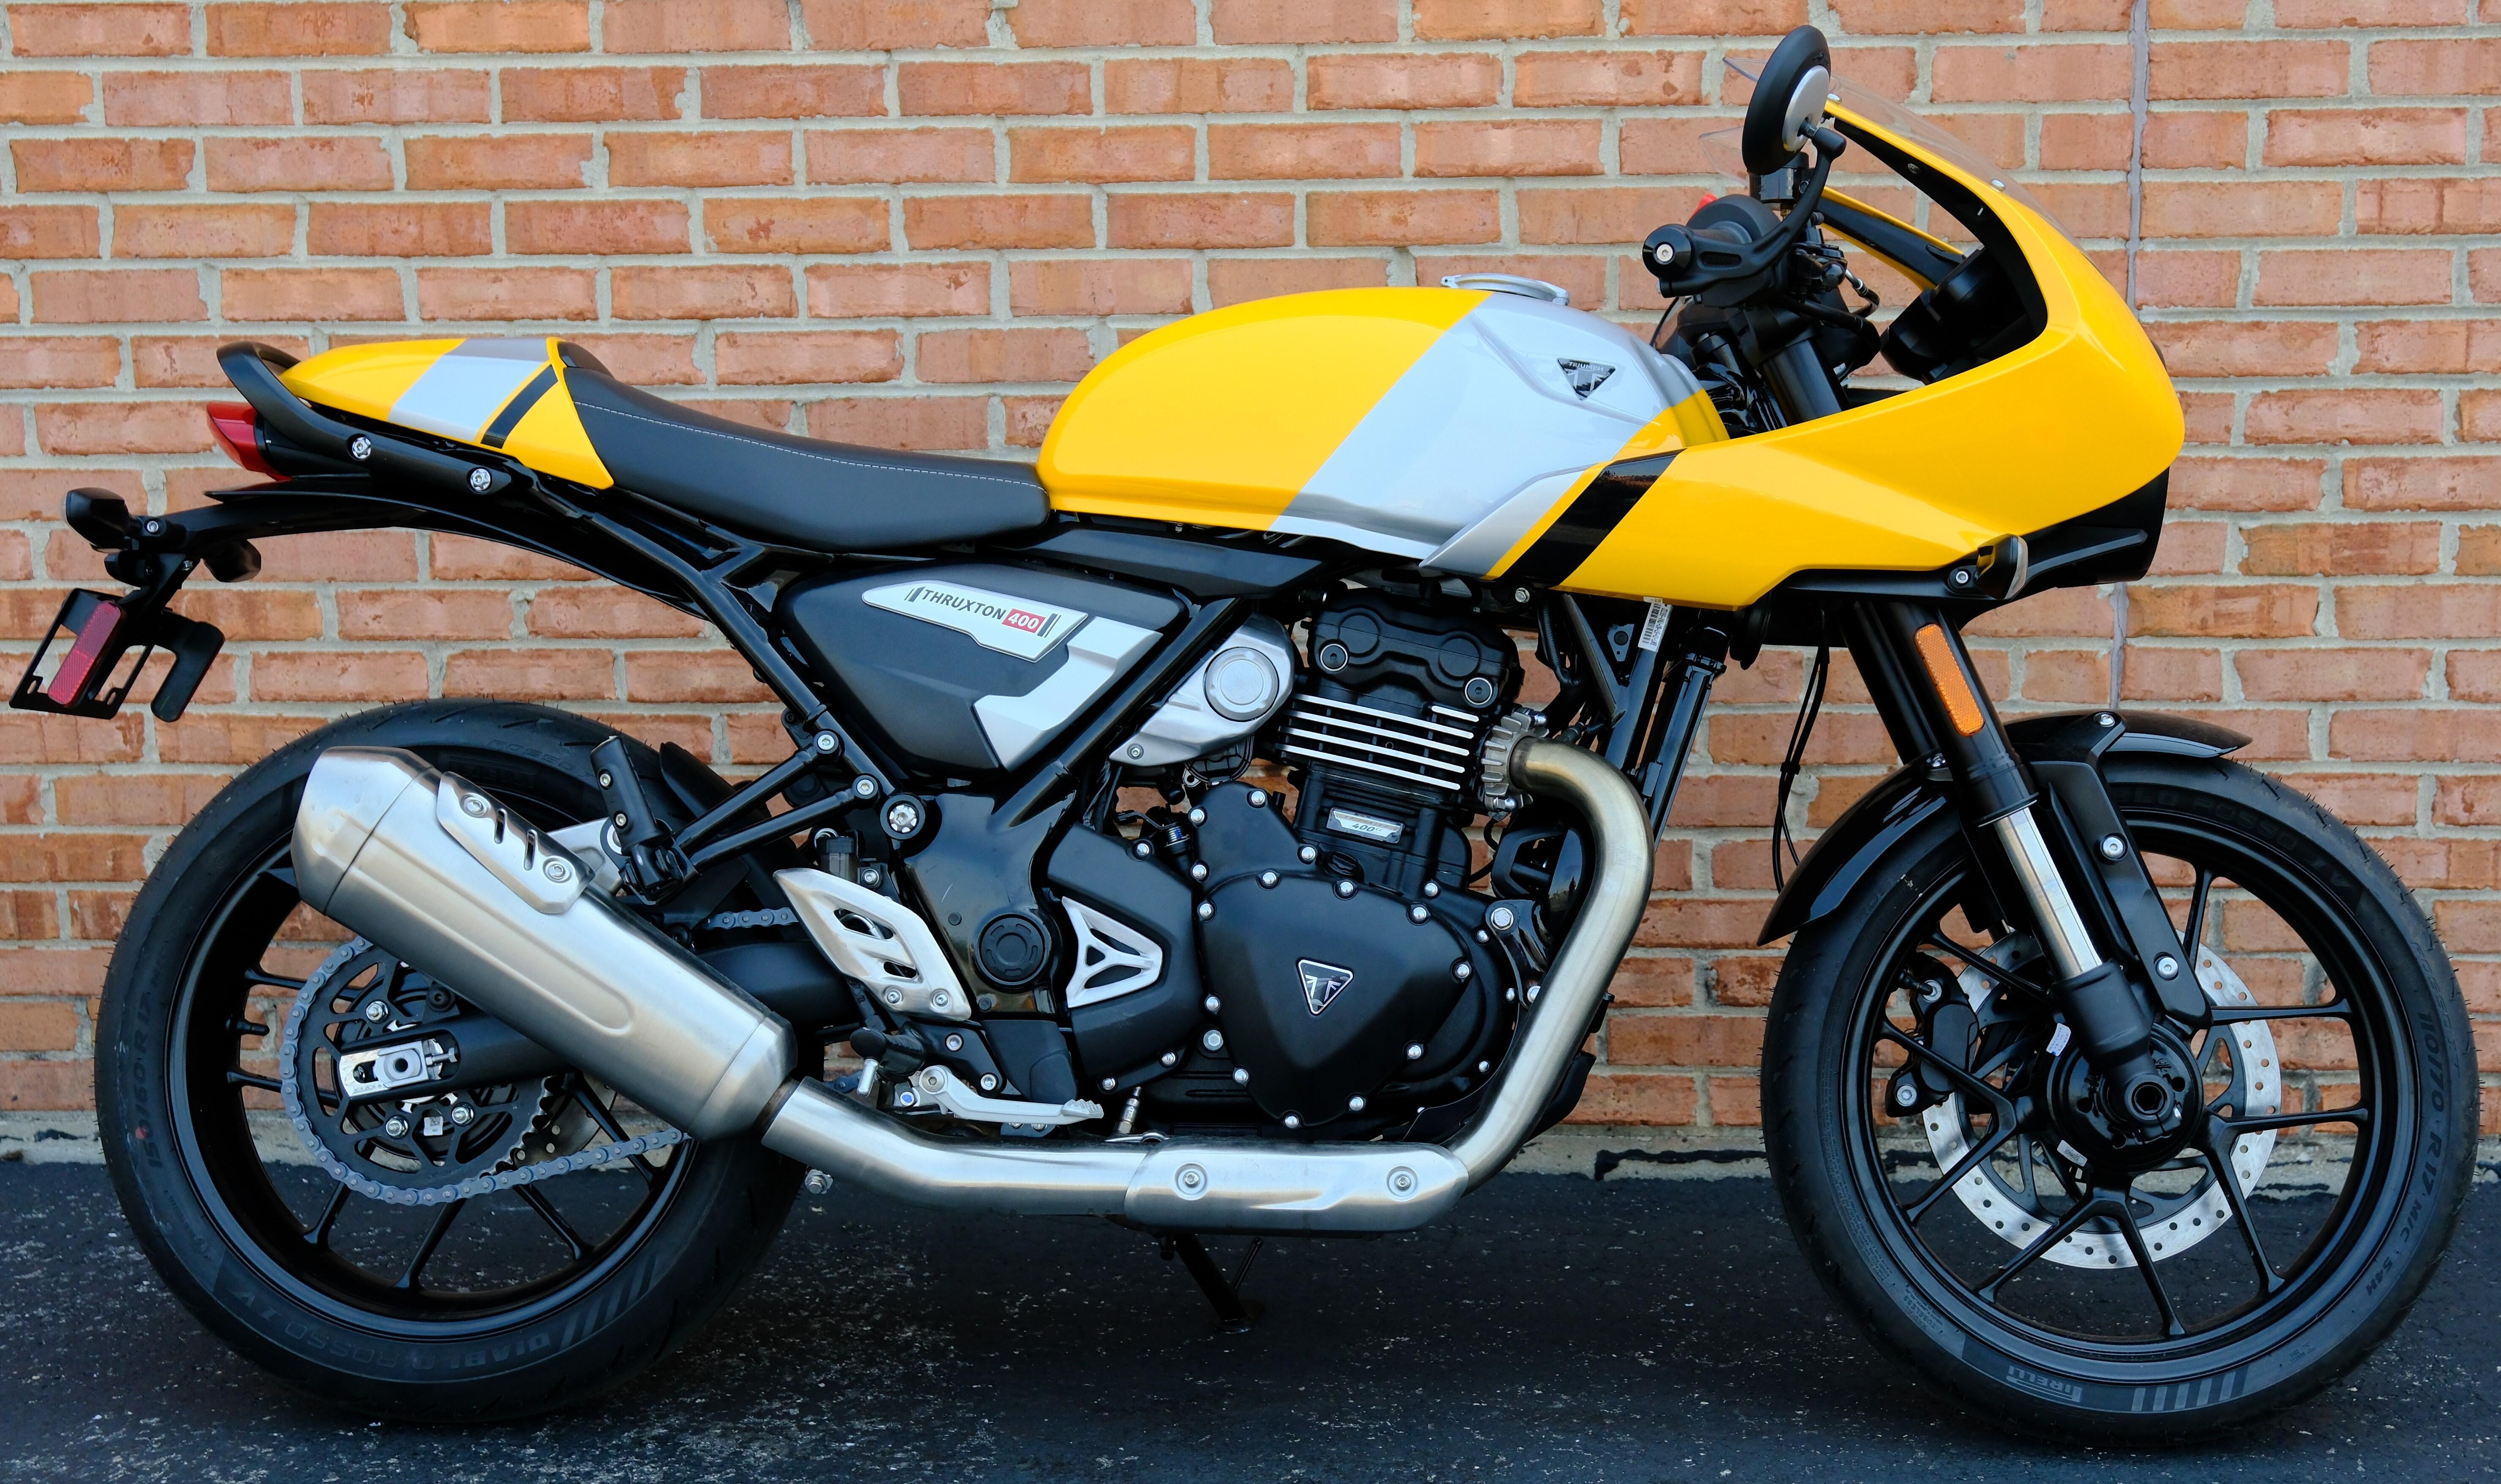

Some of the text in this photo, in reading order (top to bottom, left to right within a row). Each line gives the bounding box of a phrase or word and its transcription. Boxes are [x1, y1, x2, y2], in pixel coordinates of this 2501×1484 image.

[1569, 361, 1604, 372] TRIUMPH
[922, 589, 1039, 629] THRUXTON 400
[2193, 796, 2298, 850] ROSSO
[2419, 1013, 2444, 1112] 110/70
[133, 1062, 164, 1171] 150/60
[2400, 1200, 2422, 1241] M/C
[2366, 1258, 2392, 1295] 54H
[1904, 1296, 1935, 1328] TUBELESS
[285, 1321, 397, 1368] ROSSO
[413, 1332, 550, 1369] DIABLO
[2006, 1366, 2082, 1402] PIRELLI
